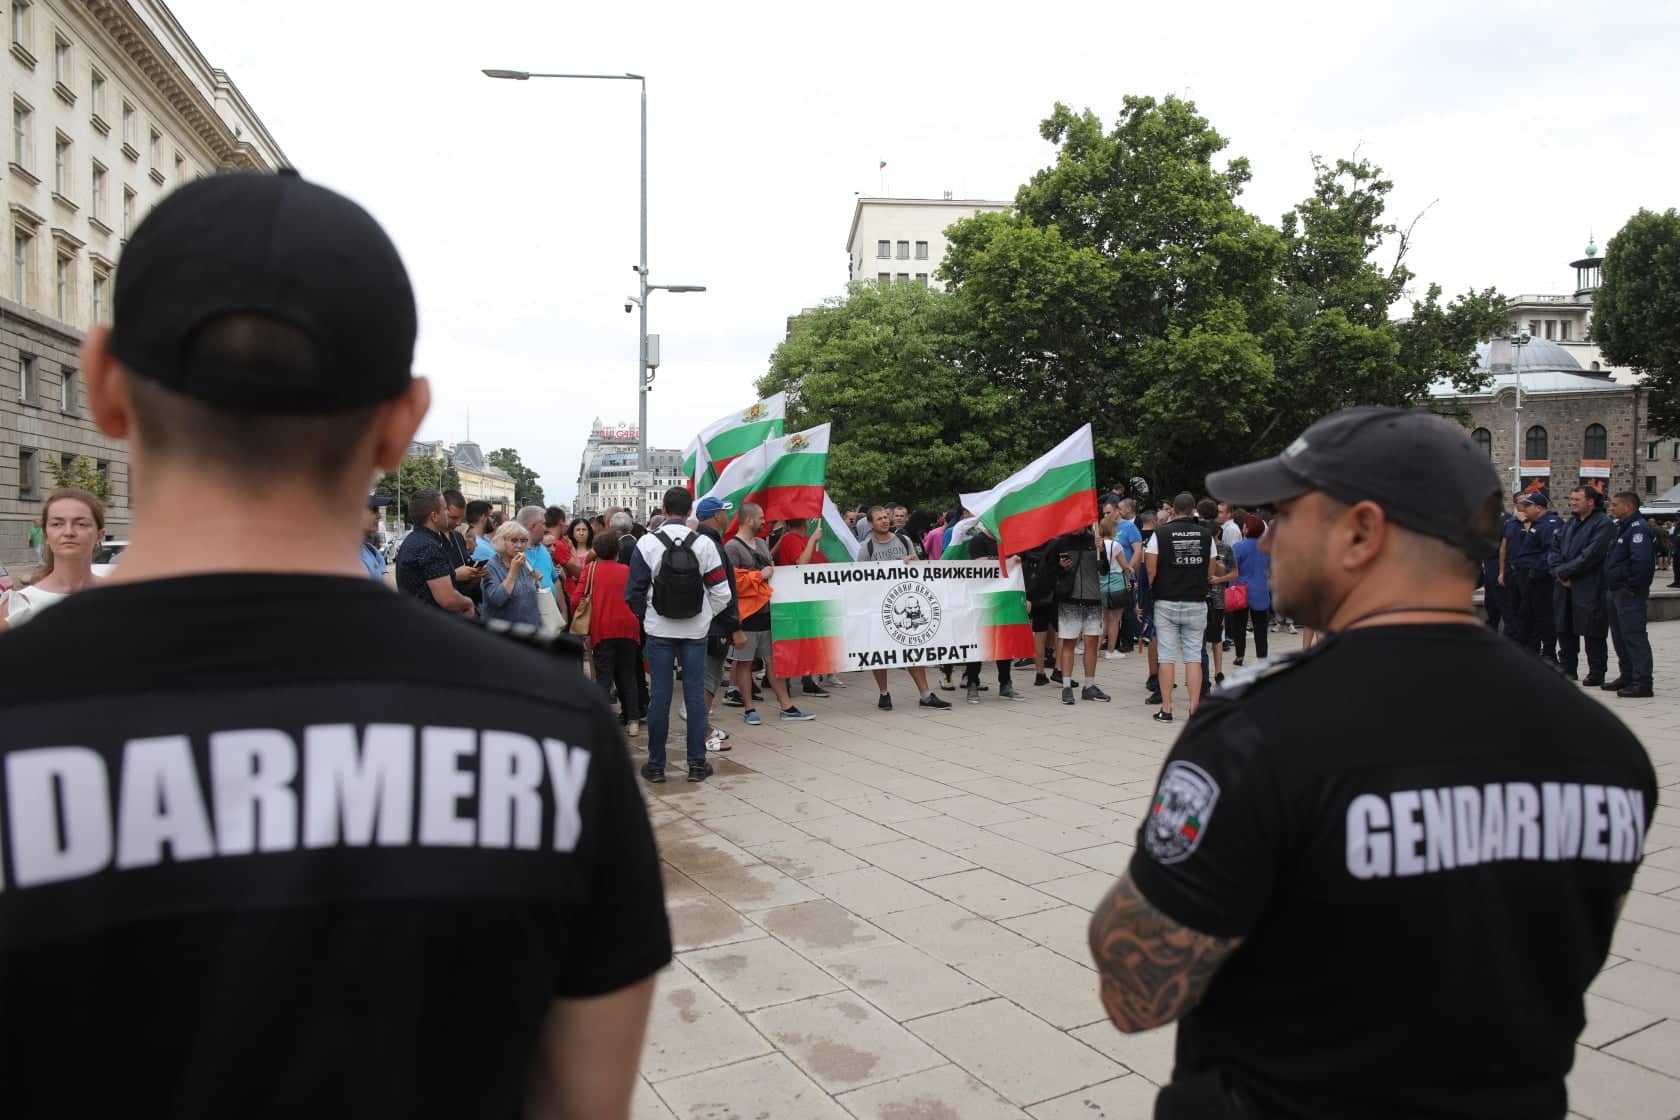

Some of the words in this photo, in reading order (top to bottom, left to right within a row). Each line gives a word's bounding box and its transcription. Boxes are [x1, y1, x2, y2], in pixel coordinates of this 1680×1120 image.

[600, 430, 640, 439] BULGARI
[804, 567, 919, 586] НАЦИОНАЛНО
[923, 566, 1000, 582] ДВИЖЕНИЕ
[848, 649, 897, 667] "ХАН
[902, 643, 978, 664] КУБРАТ"
[0, 723, 591, 890] DARMERY
[1346, 781, 1645, 880] GENDARMERY
